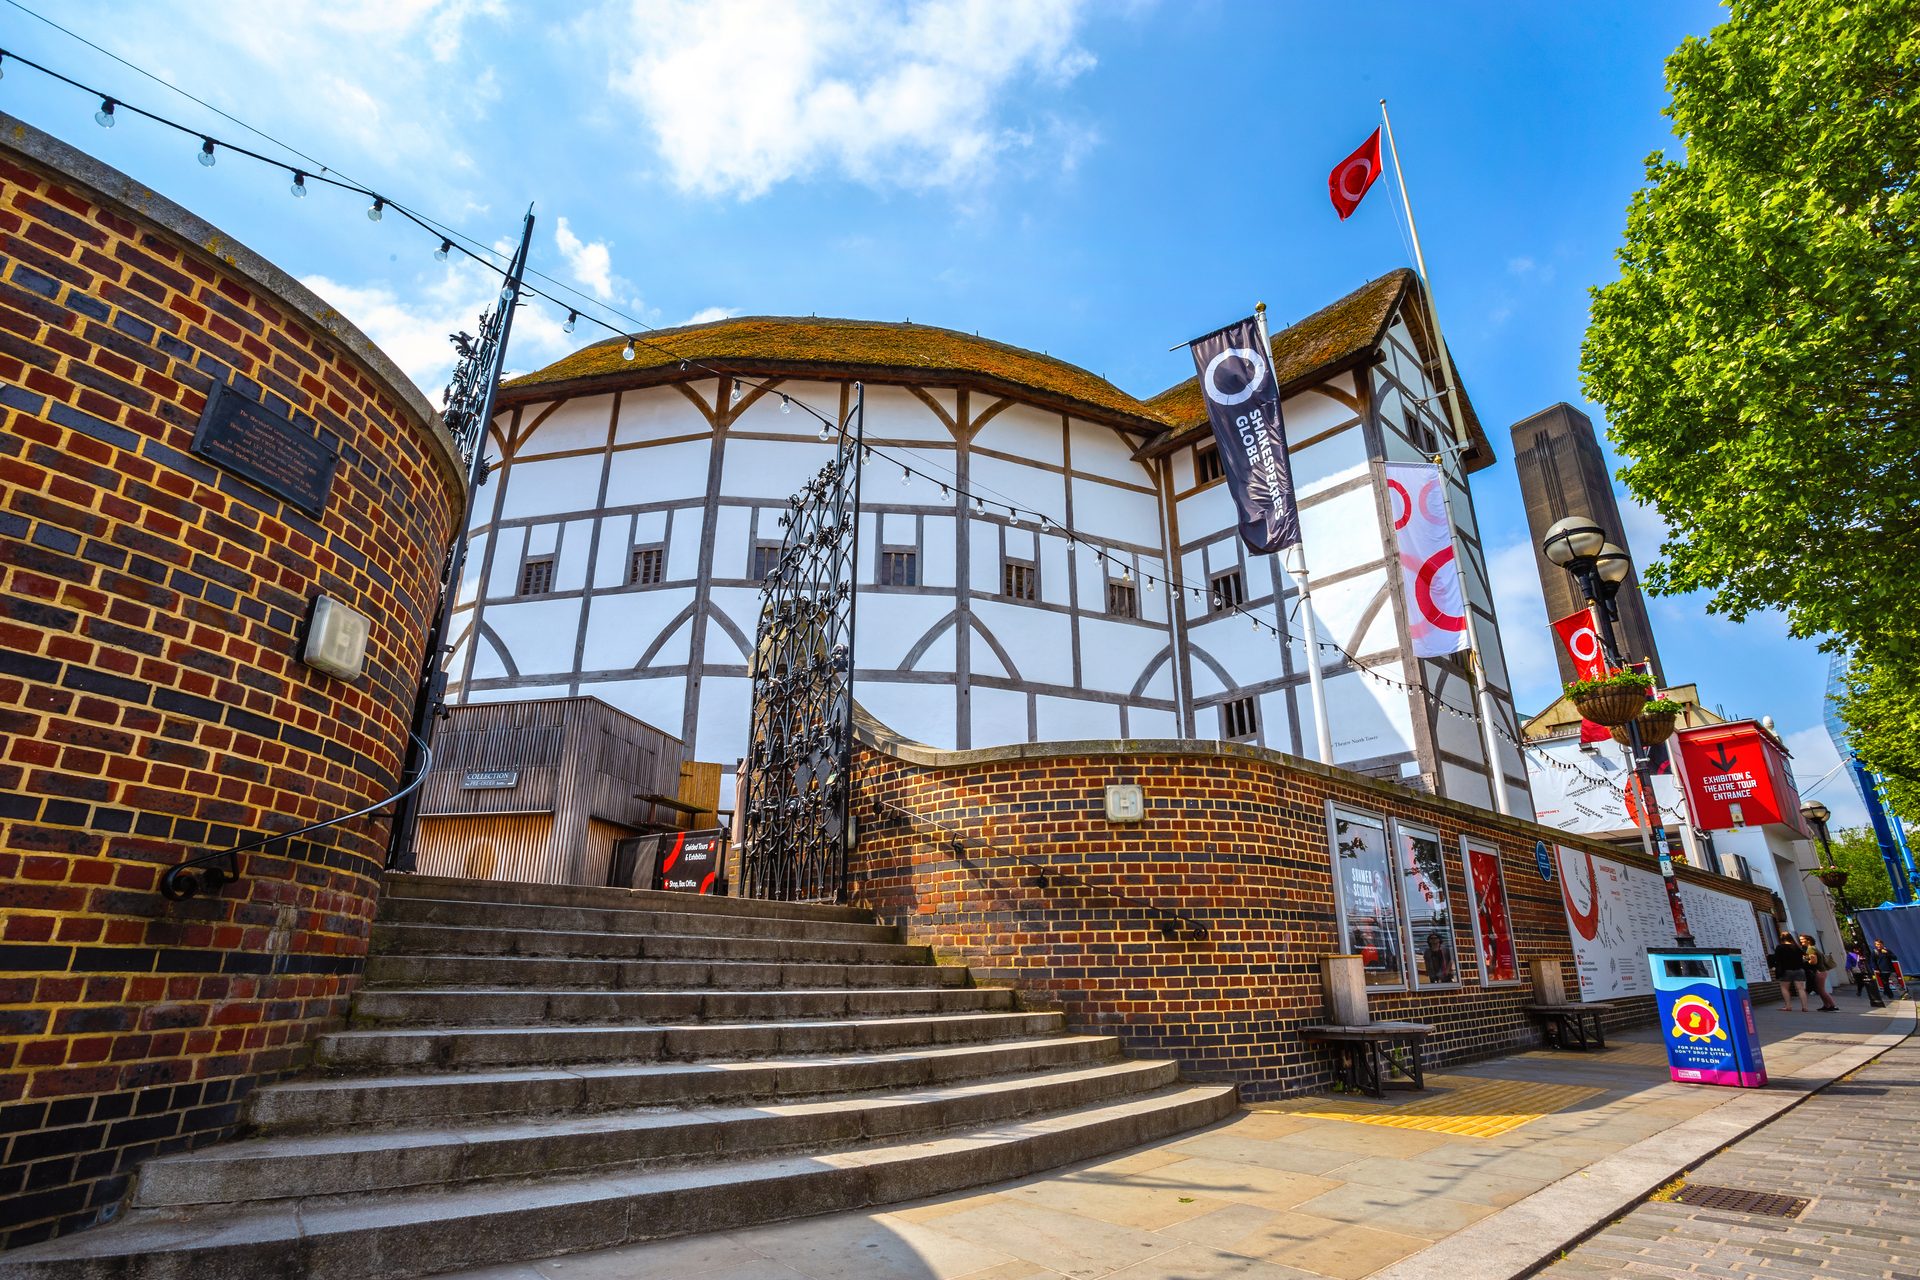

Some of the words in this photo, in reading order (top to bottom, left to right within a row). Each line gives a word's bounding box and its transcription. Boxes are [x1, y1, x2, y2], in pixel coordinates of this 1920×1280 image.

[1235, 416, 1261, 466] GLOBE
[1250, 409, 1284, 521] SHAKESPEARE'S
[1703, 772, 1744, 784] EXHIBITION
[1745, 771, 1752, 780] &
[1704, 782, 1736, 793] THEATRE
[1736, 780, 1758, 790] TOUR
[1713, 790, 1752, 800] ENTRANCE
[1574, 802, 1604, 819] SHAKESPEARE
[1352, 868, 1372, 883] SUMMER
[670, 880, 680, 888] Shop,
